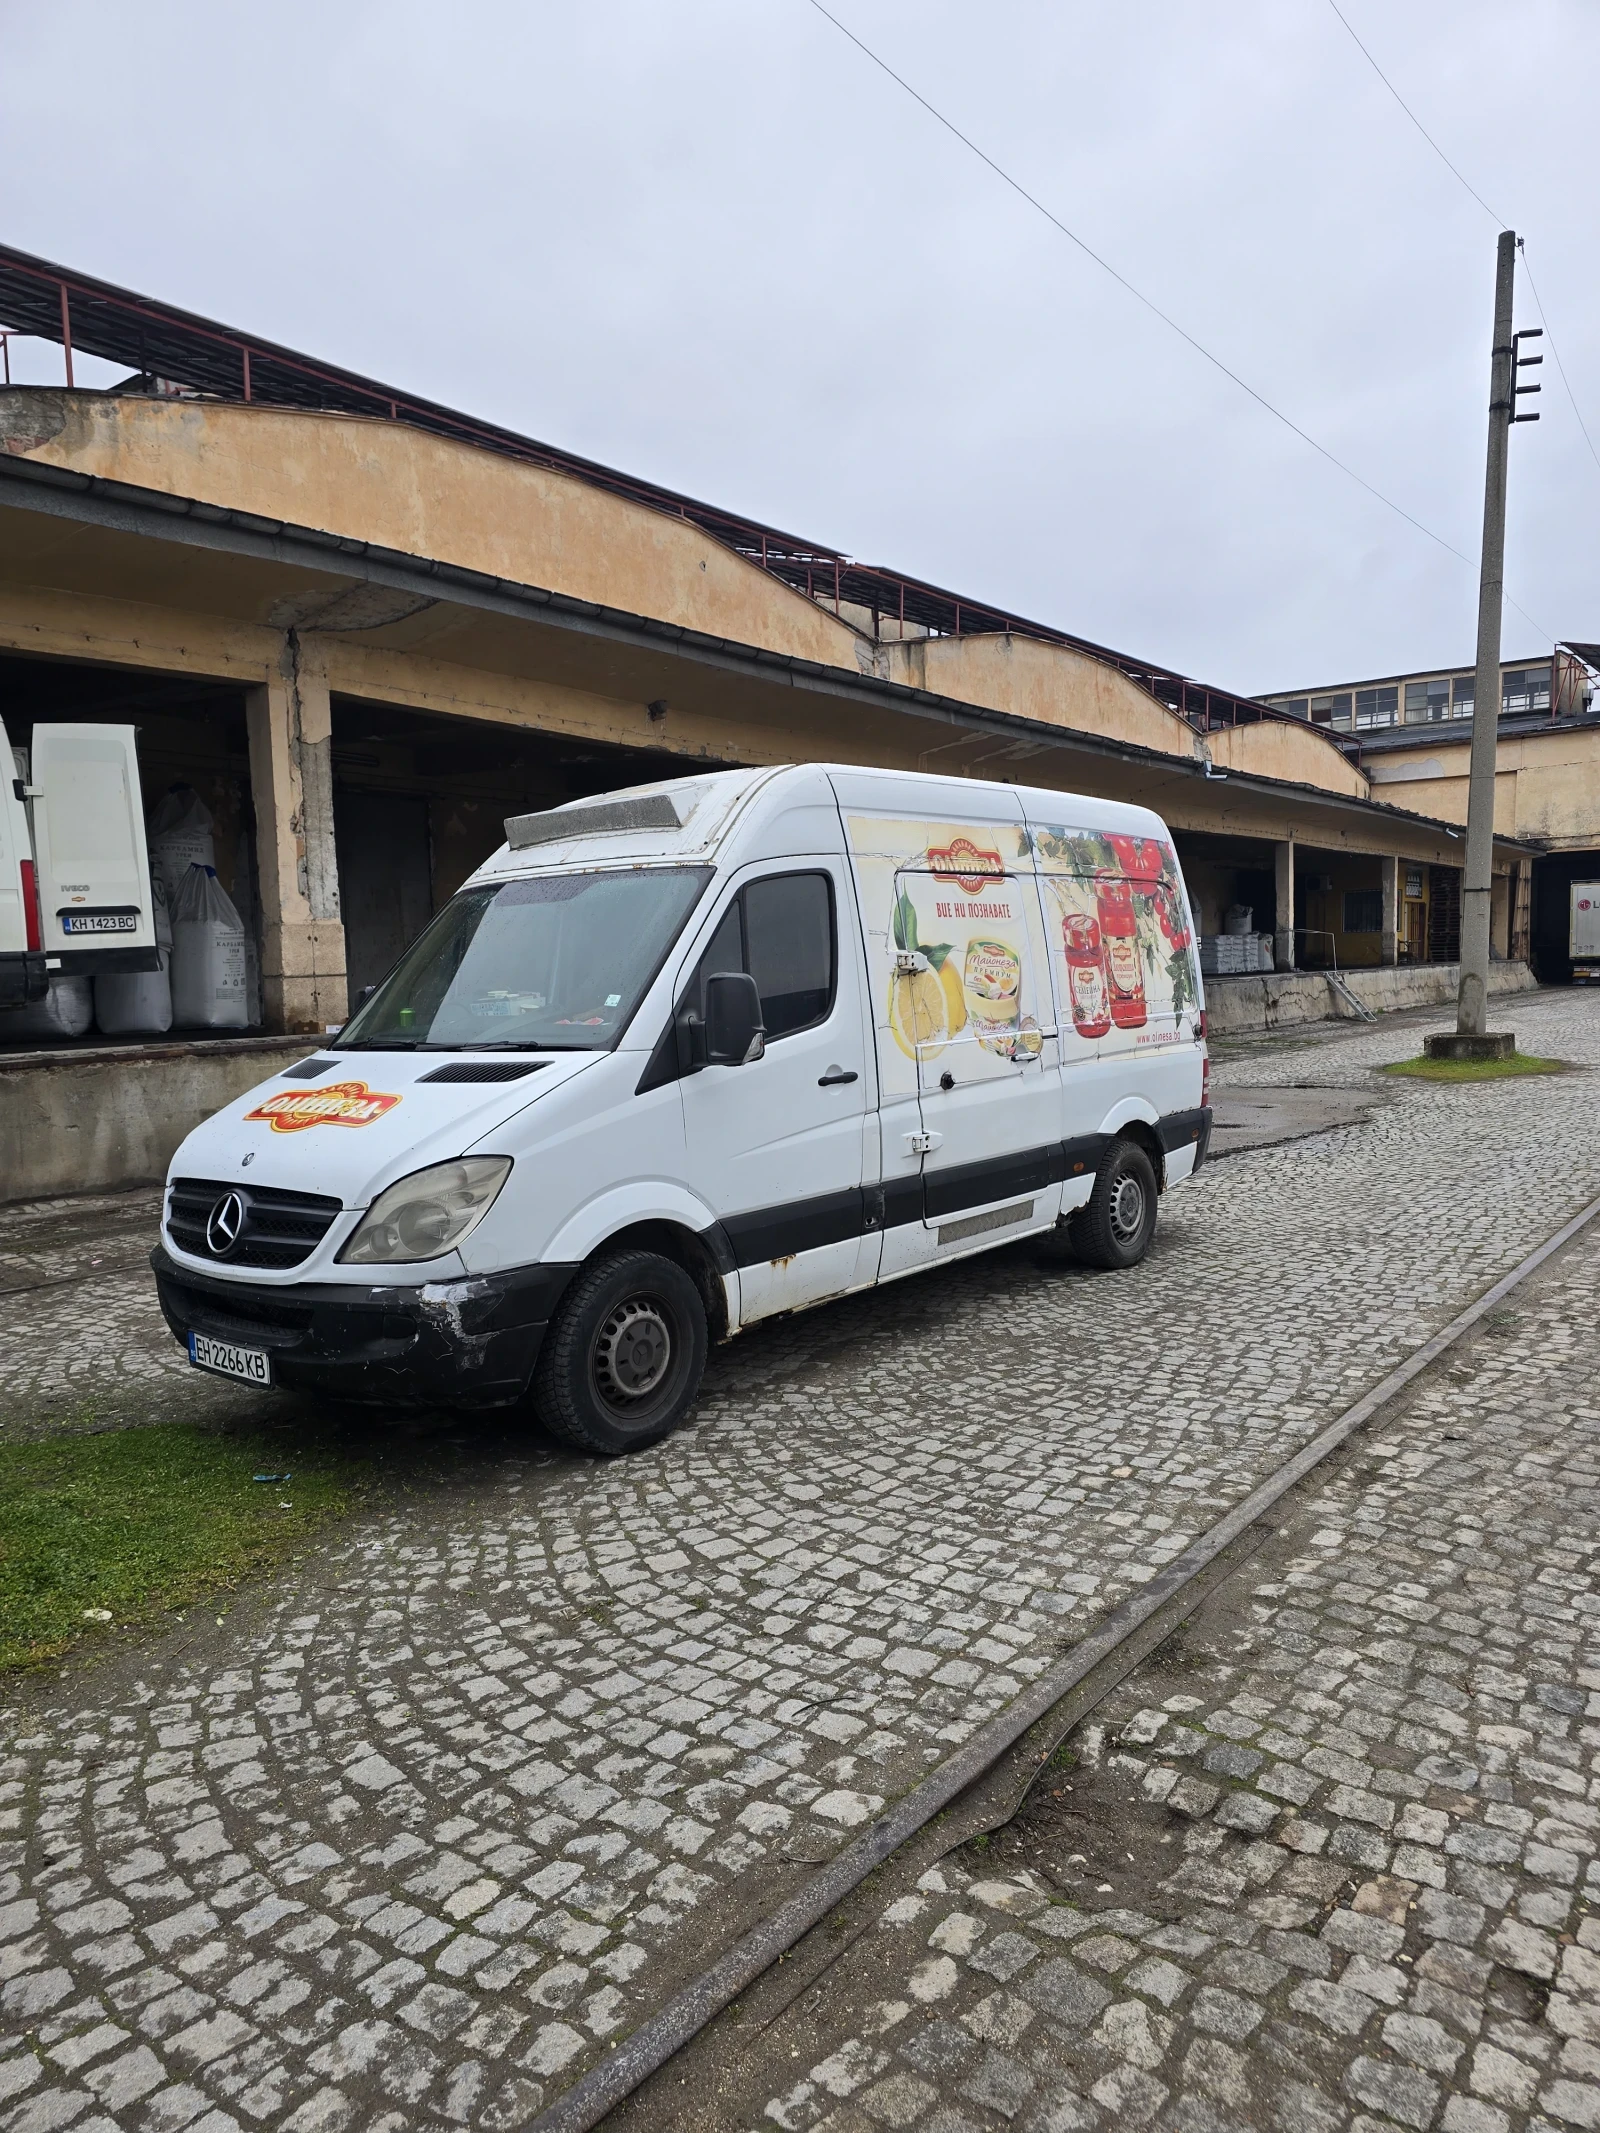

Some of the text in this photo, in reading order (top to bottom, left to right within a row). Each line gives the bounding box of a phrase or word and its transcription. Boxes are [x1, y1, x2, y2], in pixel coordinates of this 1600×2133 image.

[61, 884, 90, 892] IVECO
[936, 902, 1012, 919] ВИЕ НИ ПОЗНАВАТЕ
[1593, 900, 1600, 909] L
[969, 954, 1017, 969] Майонеза
